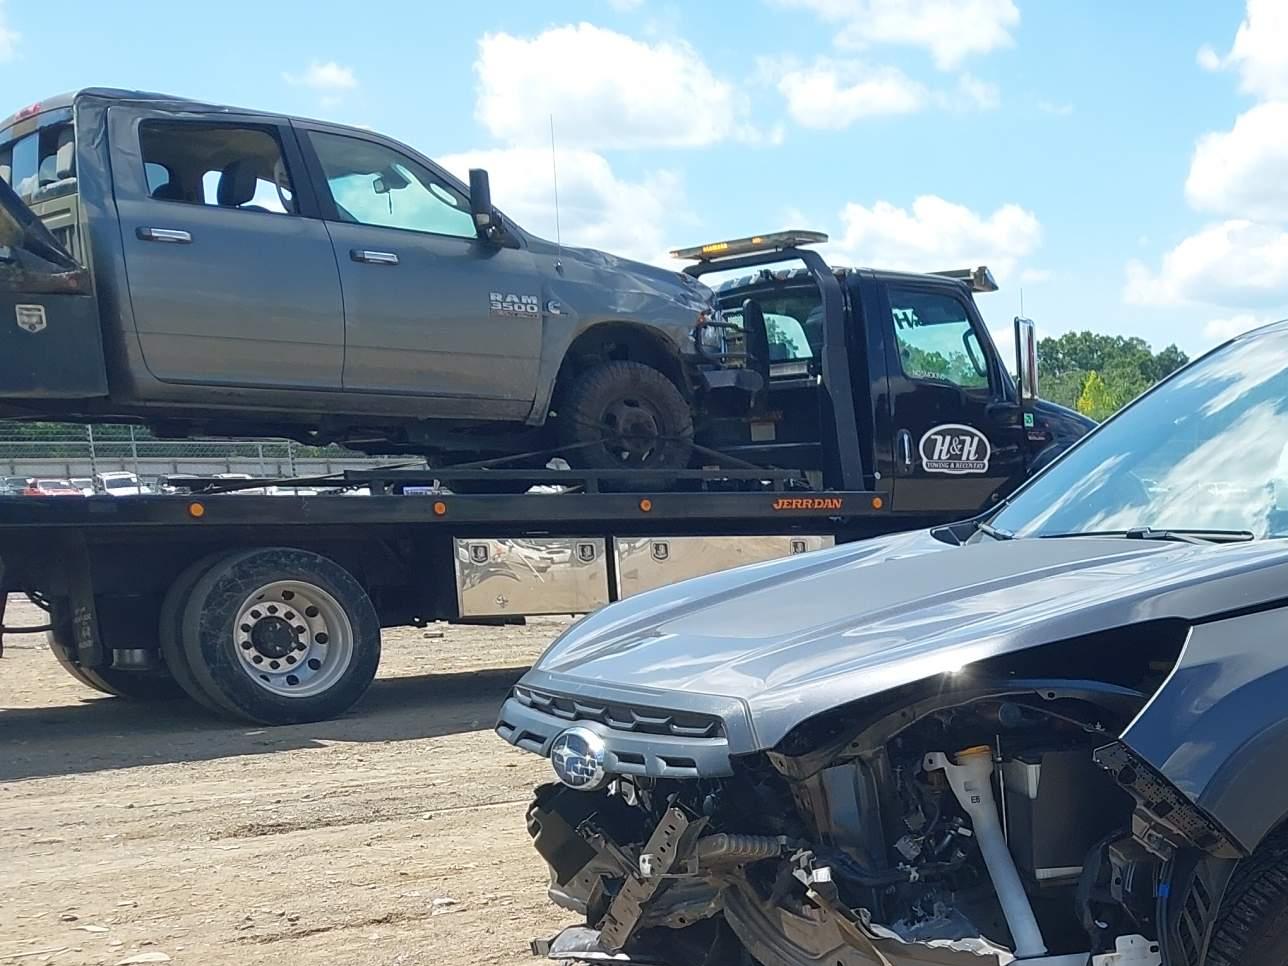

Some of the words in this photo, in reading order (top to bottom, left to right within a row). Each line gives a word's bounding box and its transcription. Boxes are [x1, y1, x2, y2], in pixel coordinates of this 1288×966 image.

[490, 292, 538, 304] RAM
[490, 301, 539, 313] 3500
[930, 435, 980, 461] H&H
